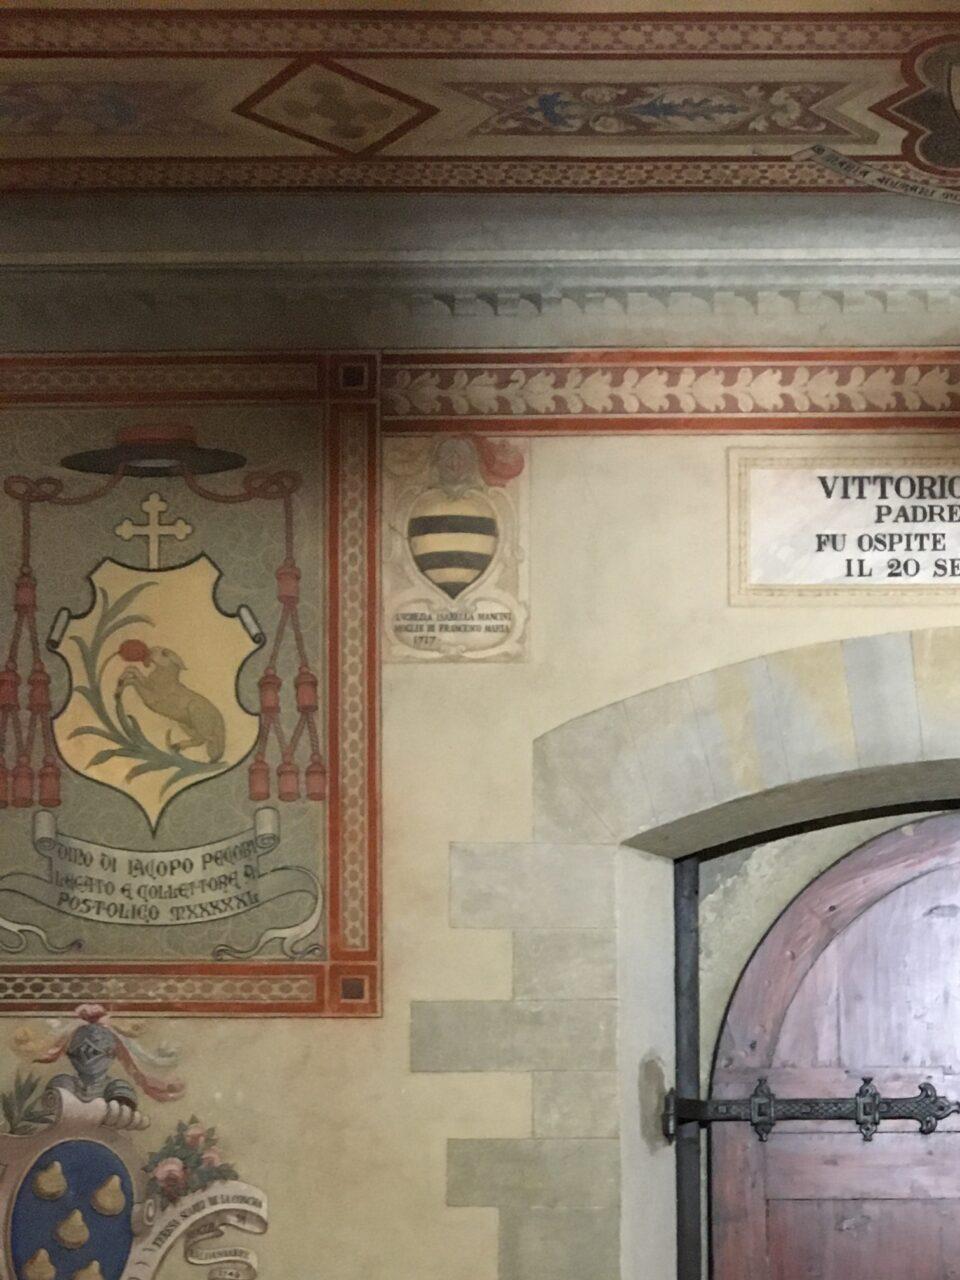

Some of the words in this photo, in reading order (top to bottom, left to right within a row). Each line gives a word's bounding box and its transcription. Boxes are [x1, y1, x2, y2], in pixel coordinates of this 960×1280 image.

[816, 534, 846, 552] FU
[857, 533, 946, 552] OSPITE
[845, 559, 873, 577] IL
[887, 558, 921, 577] 20
